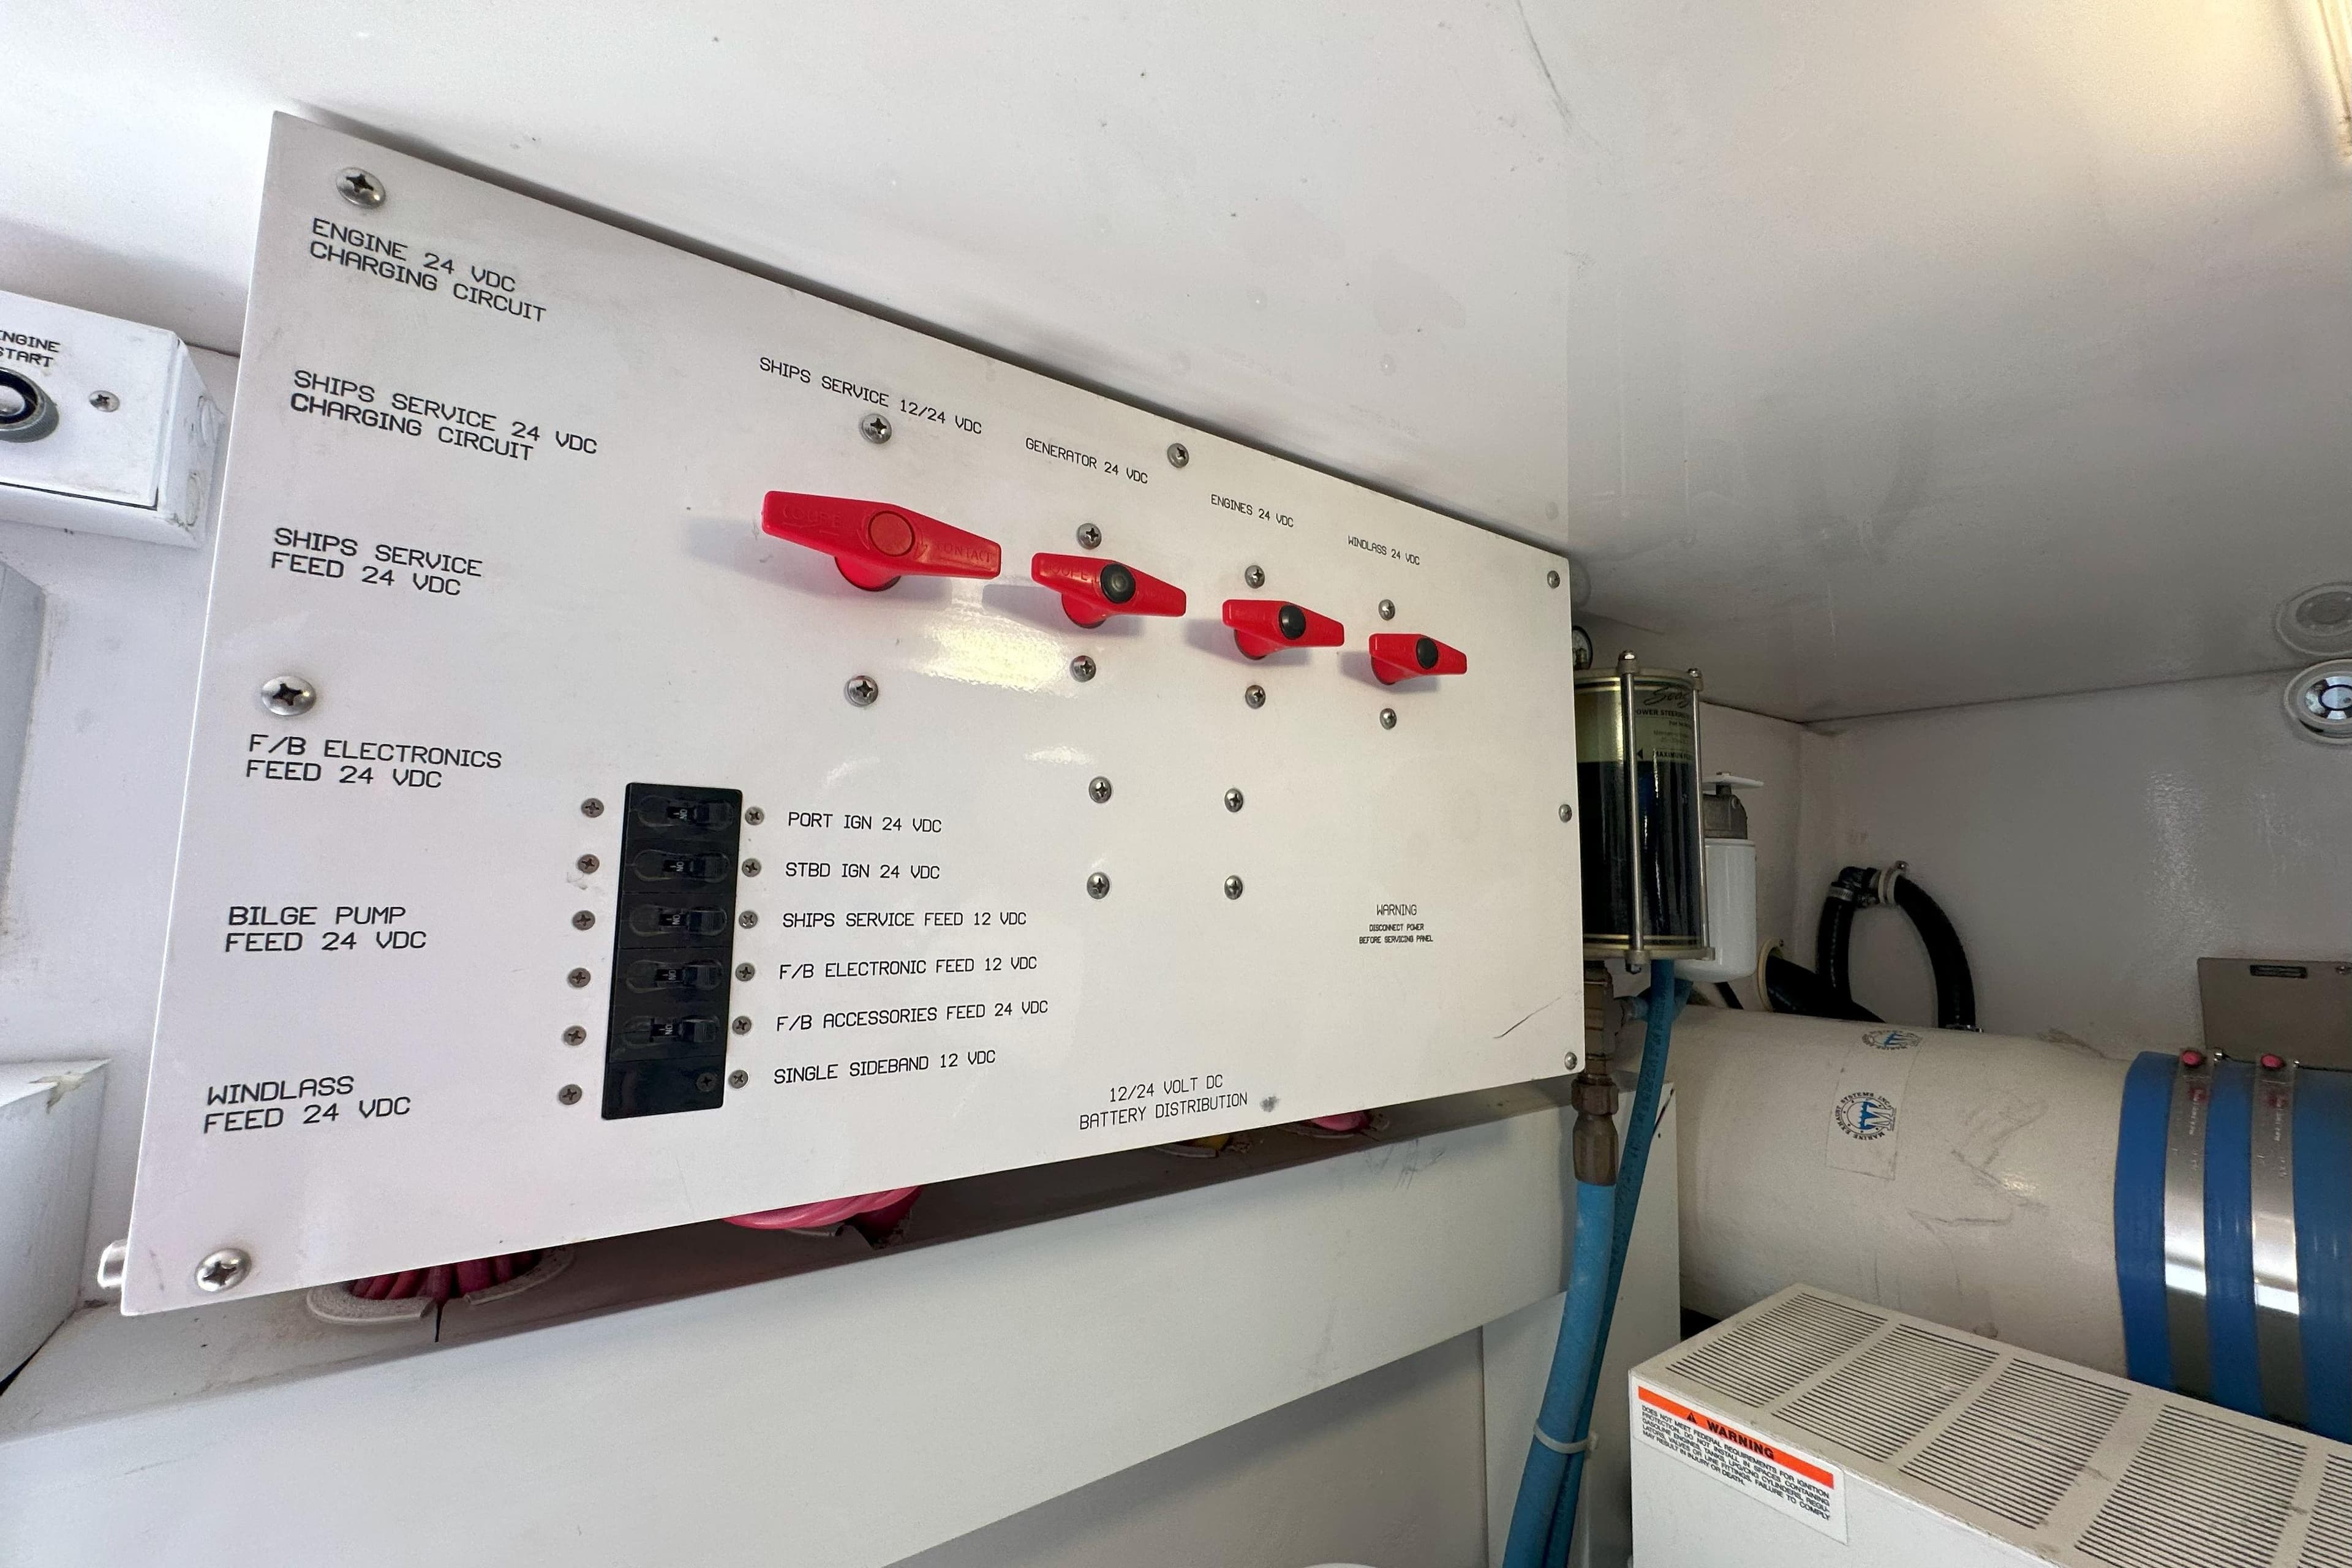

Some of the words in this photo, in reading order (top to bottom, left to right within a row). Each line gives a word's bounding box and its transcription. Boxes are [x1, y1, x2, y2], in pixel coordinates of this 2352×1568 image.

[312, 217, 409, 262] ENGINE
[423, 252, 455, 275] 24
[471, 265, 516, 293] VDC
[309, 241, 438, 292] CHARGING
[453, 283, 547, 322] CIRCUIT
[293, 369, 375, 403] SHIPS
[393, 393, 496, 431] SERVICE
[511, 421, 541, 442] 24
[555, 431, 598, 454] VDC
[759, 356, 811, 383] SHIPS
[821, 375, 890, 408] SERVICE
[900, 399, 946, 424] 12/24
[955, 415, 982, 435] VDC
[290, 392, 423, 437] CHARGING
[438, 426, 534, 461] CIRCUIT
[1025, 437, 1098, 470] GENERATOR
[1104, 461, 1119, 476] 24
[1126, 467, 1148, 484] VDC
[1211, 494, 1253, 516] ENGINES
[1258, 508, 1271, 521] 24
[1275, 513, 1294, 528] VDC
[274, 527, 358, 557] SHIPS
[374, 543, 483, 577] SERVICE
[1348, 535, 1387, 556] WINDLASS
[1391, 548, 1401, 560] 24
[1405, 552, 1420, 566] VDC
[271, 551, 345, 578] FEED
[361, 565, 395, 587] 24
[412, 572, 461, 596] VDC
[249, 733, 307, 756] F/B
[323, 739, 502, 769] ELECTRONICS
[245, 759, 322, 782] FEED
[338, 765, 374, 785] 24
[392, 768, 443, 788] VDC
[788, 811, 834, 829] PORT
[843, 814, 872, 830] IGN
[881, 816, 902, 832] 24
[912, 818, 942, 833] VDC
[785, 862, 831, 878] STBD
[841, 863, 870, 878] IGN
[880, 864, 900, 879] 24
[910, 865, 940, 880] VDC
[227, 906, 318, 926] BILGE
[335, 906, 407, 925] PUMP
[782, 912, 835, 928] SHIPS
[845, 912, 915, 927] SERVICE
[924, 912, 963, 927] FEED
[973, 911, 991, 926] 12
[1000, 911, 1027, 925] VDC
[1369, 923, 1404, 932] DISCONNECT
[1406, 923, 1425, 932] POWER
[1376, 903, 1417, 916] WARNING
[224, 932, 303, 953] FEED
[321, 931, 358, 951] 24
[375, 930, 427, 949] VDC
[1359, 935, 1382, 944] BEFORE
[1384, 935, 1414, 944] SERVICING
[1415, 935, 1434, 943] PANEL
[779, 963, 815, 980] F/B
[825, 959, 927, 978] ELECTRONIC
[935, 958, 974, 974] FEED
[984, 957, 1002, 971] 12
[1010, 956, 1038, 970] VDC
[776, 1014, 813, 1032] F/B
[823, 1006, 938, 1029] ACCESSORIES
[946, 1003, 986, 1020] FEED
[994, 1002, 1013, 1017] 24
[1021, 1000, 1049, 1015] VDC
[774, 1063, 839, 1085] SINGLE
[849, 1055, 929, 1077] SIDEBAND
[940, 1053, 959, 1068] 12
[967, 1049, 996, 1065] VDC
[206, 1075, 355, 1106] WINDLASS
[1110, 1082, 1155, 1102] 12/24
[1163, 1077, 1199, 1095] VOLT
[1206, 1074, 1223, 1090] DC
[203, 1107, 284, 1134] FEED
[302, 1102, 340, 1125] 24
[358, 1096, 412, 1119] VDC
[1079, 1106, 1147, 1131] BATTERY
[1155, 1091, 1248, 1119] DISTRIBUTION
[1642, 1418, 1671, 1435] GASOLINE
[1707, 1420, 1774, 1460] WARNING
[1642, 1405, 1657, 1417] DOES
[1660, 1413, 1673, 1423] NOT
[1675, 1421, 1691, 1432] MEET
[1694, 1430, 1722, 1447] FEDERAL
[1724, 1444, 1777, 1473] REQUIREMENTS
[1780, 1471, 1795, 1482] FOR
[1797, 1479, 1829, 1498] IGNITION
[1643, 1430, 1654, 1441] MAY
[1657, 1438, 1679, 1452] RESULT
[1687, 1454, 1709, 1467] INJURY
[1711, 1464, 1721, 1473] OR
[1668, 1438, 1691, 1452] VALVES
[1693, 1449, 1702, 1457] OR
[1705, 1455, 1719, 1465] LINE
[1755, 1480, 1784, 1498] FAILURE
[1787, 1494, 1796, 1504] TO
[1800, 1501, 1830, 1520] COMPLY
[1697, 1438, 1709, 1447] NOT
[1714, 1446, 1740, 1463] INSTALL
[1754, 1465, 1781, 1482] SPACES
[1785, 1480, 1830, 1506] CONTAINING
